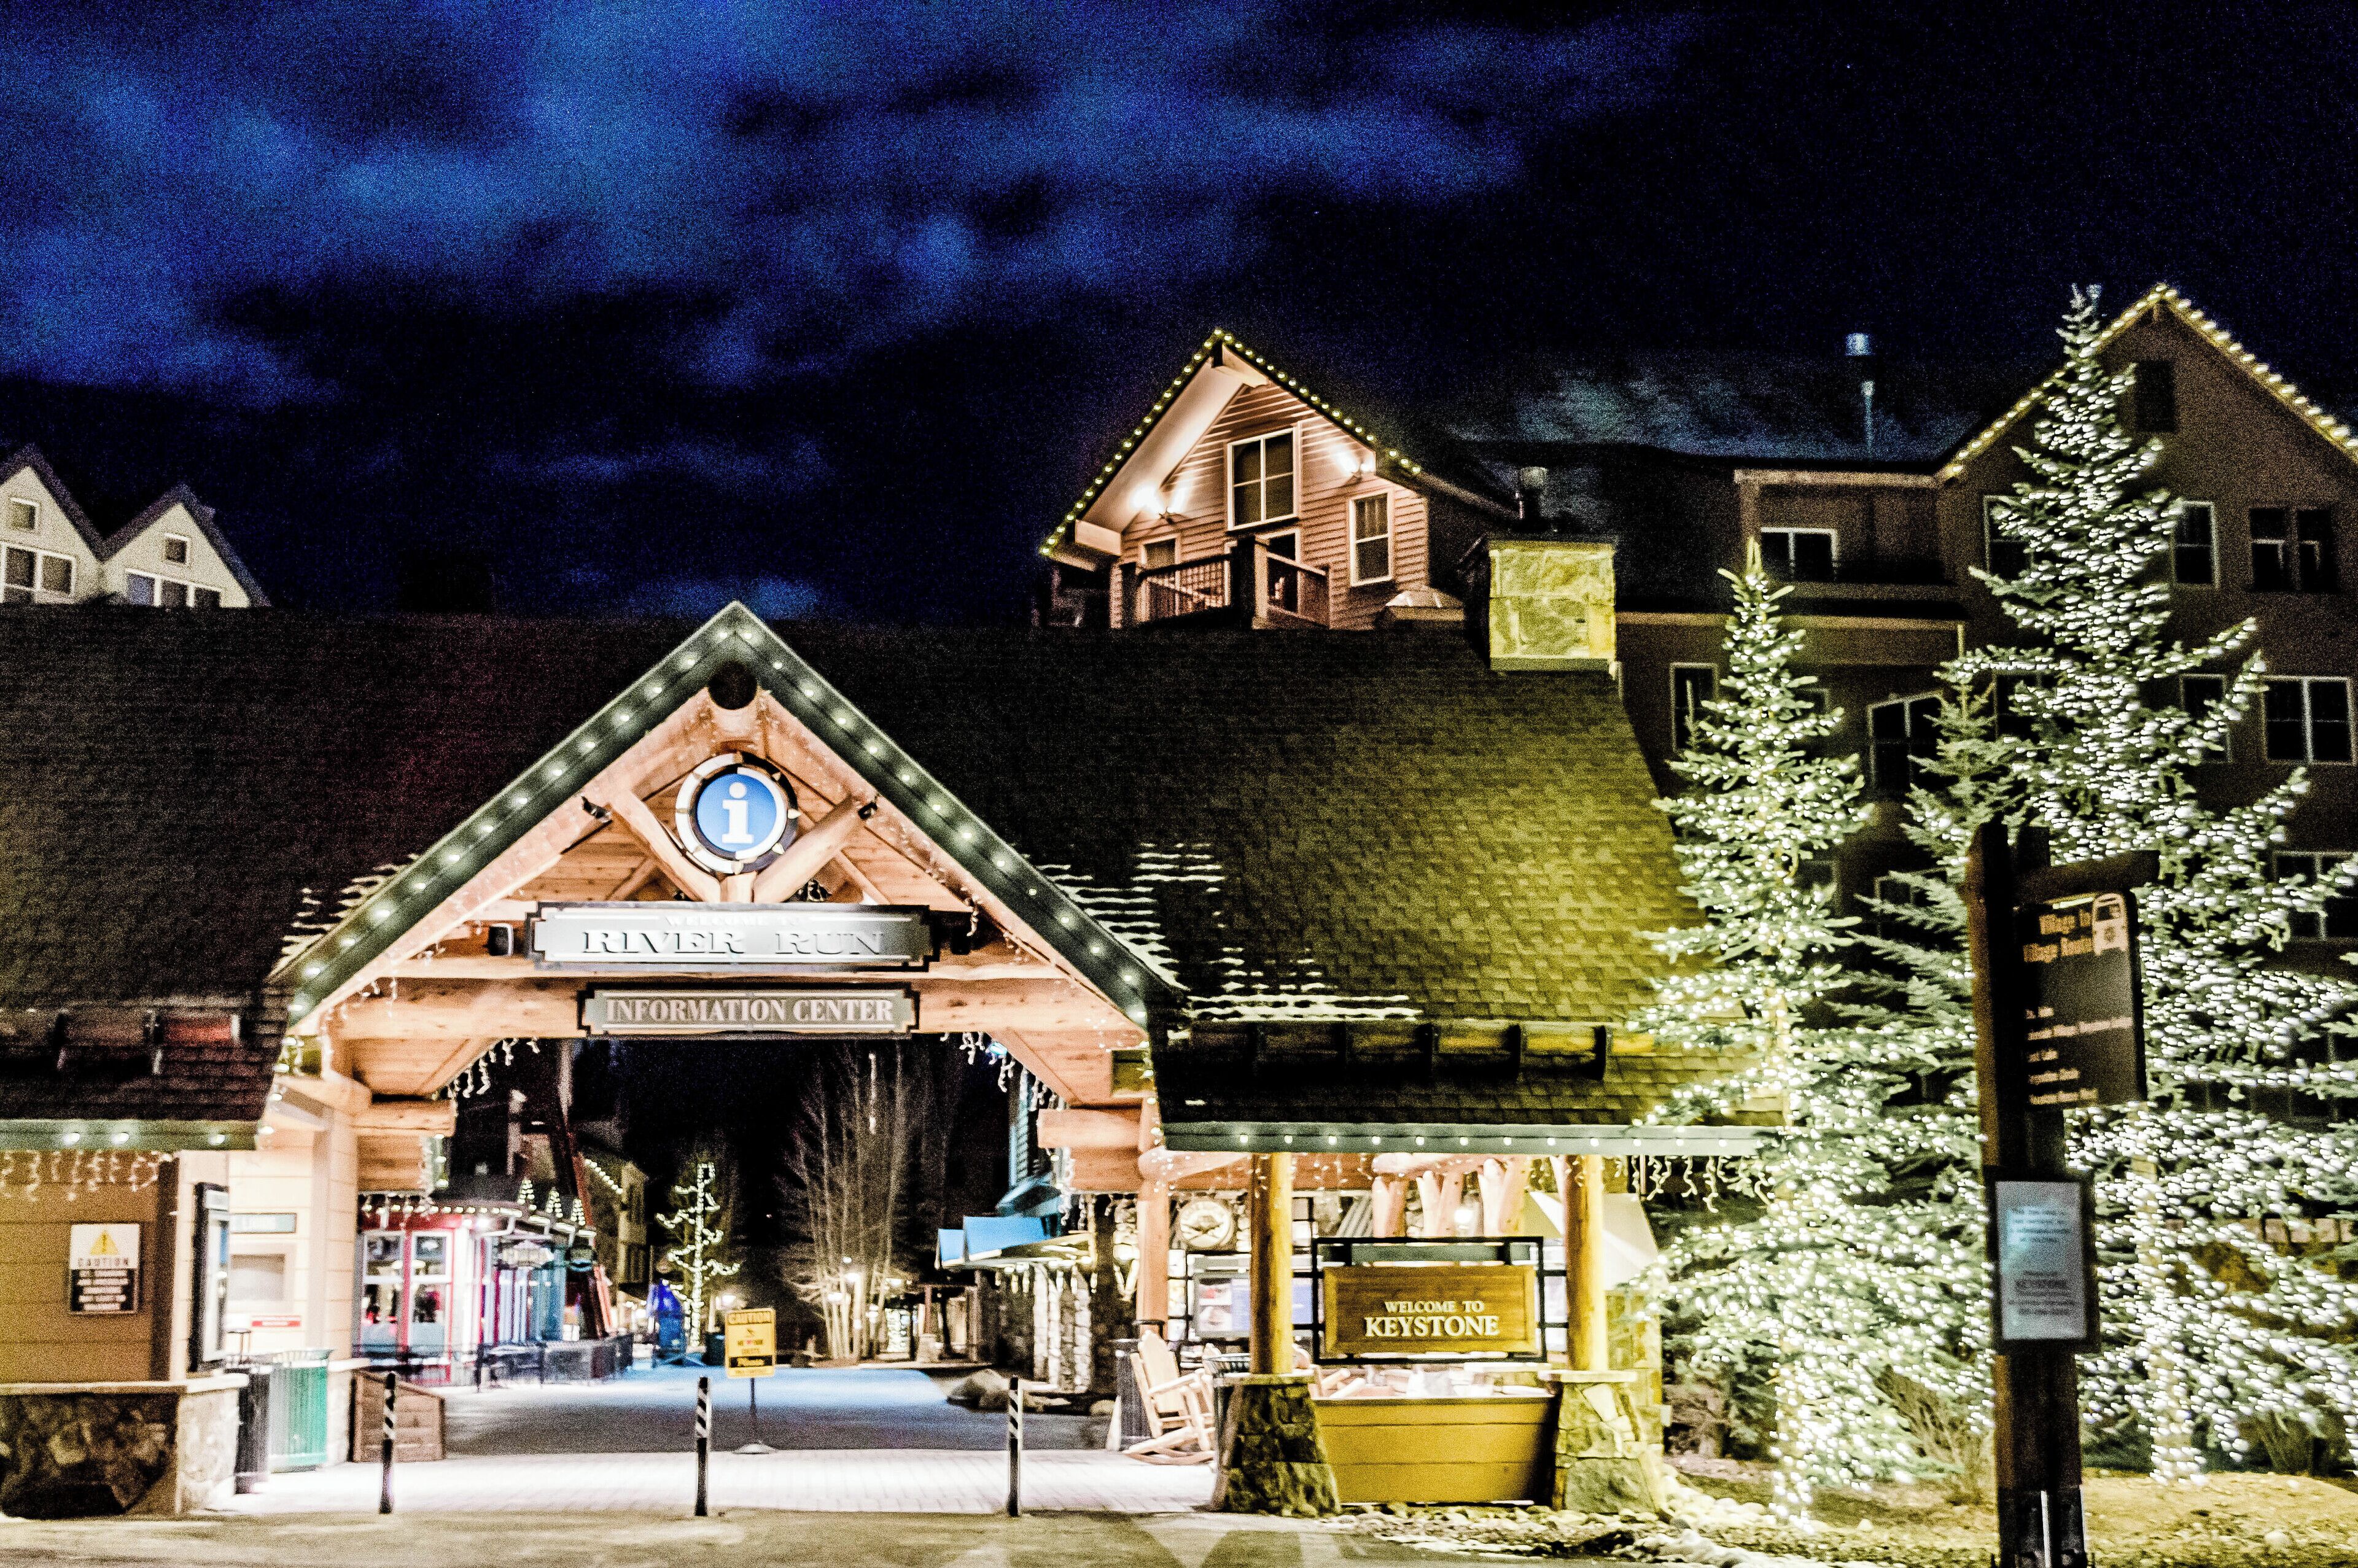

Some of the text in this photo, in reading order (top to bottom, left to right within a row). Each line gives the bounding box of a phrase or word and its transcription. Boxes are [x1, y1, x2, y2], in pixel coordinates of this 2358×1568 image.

[664, 915, 767, 926] WELCOME
[582, 930, 884, 954] RIVER RUN
[605, 998, 893, 1022] INFORMATION CENTER
[77, 1257, 130, 1268] CAUTION
[1384, 1300, 1485, 1313] WELCOME TO
[728, 1311, 772, 1325] CAUTION
[1364, 1315, 1500, 1337] KEYSTONE
